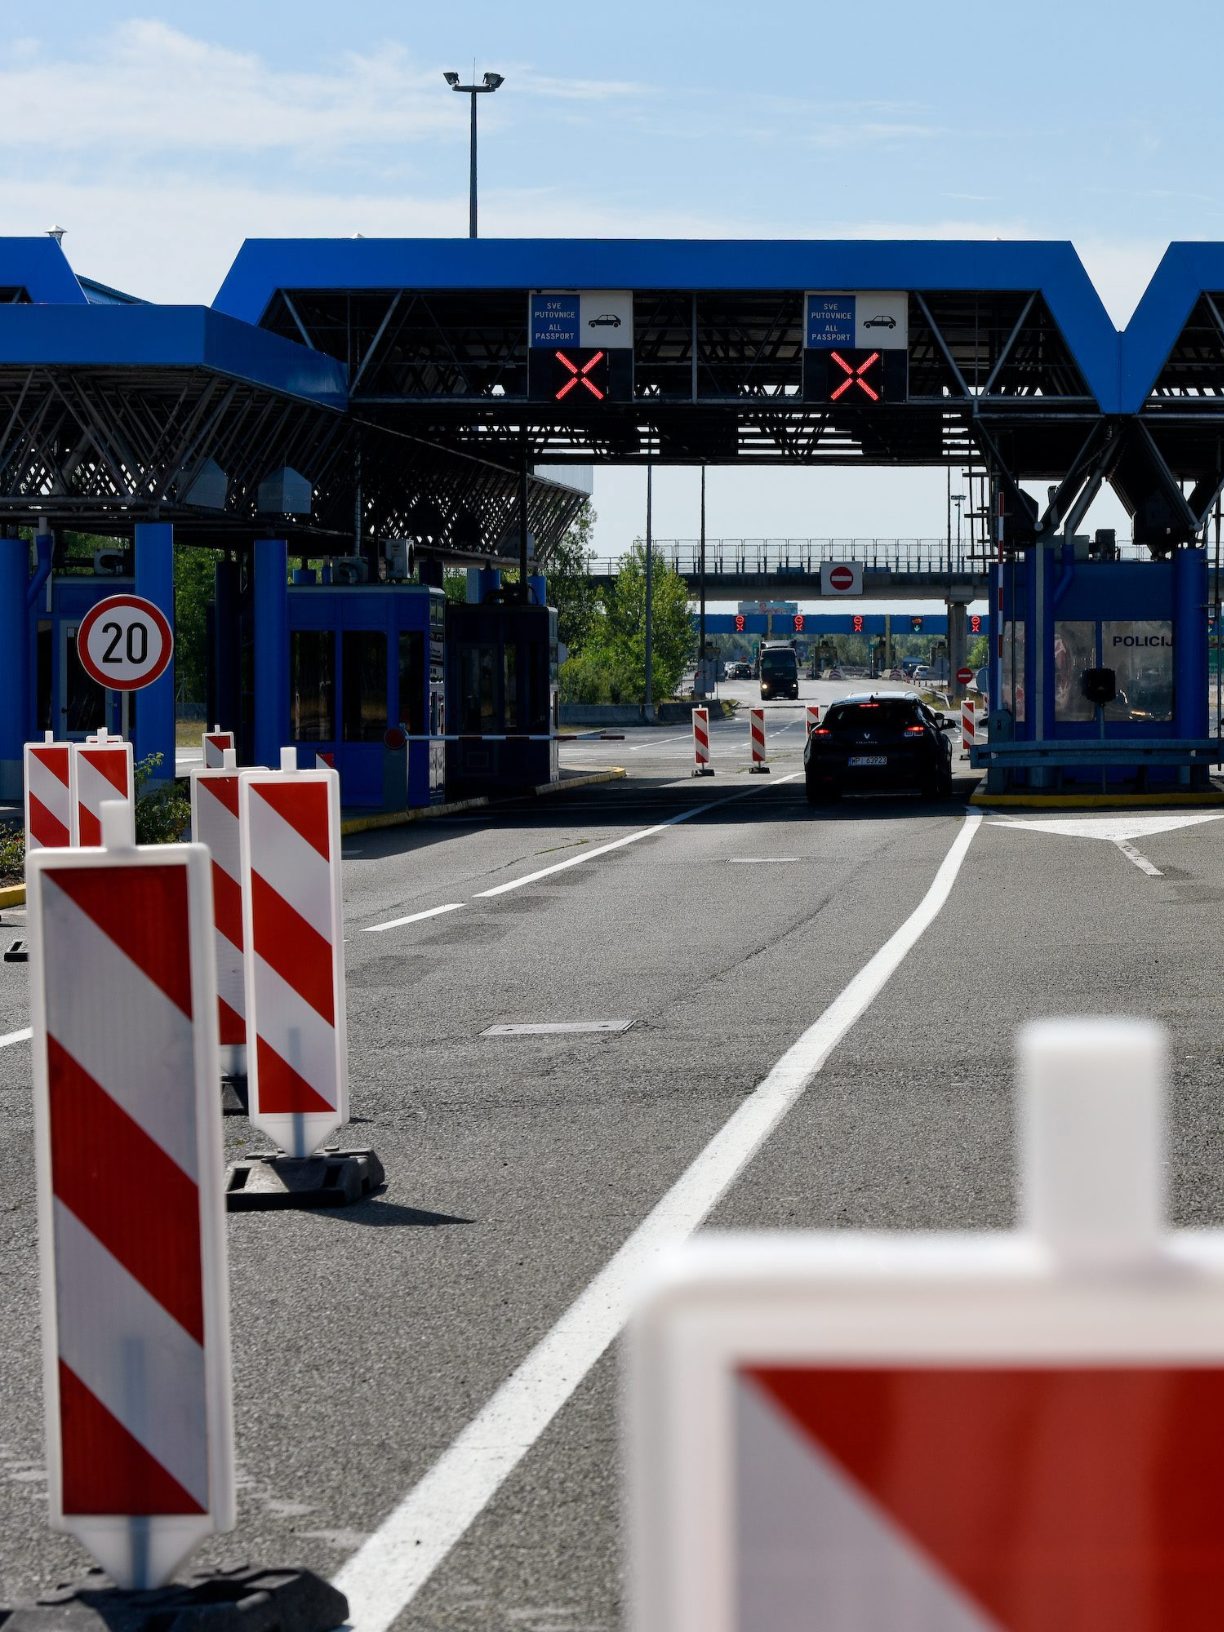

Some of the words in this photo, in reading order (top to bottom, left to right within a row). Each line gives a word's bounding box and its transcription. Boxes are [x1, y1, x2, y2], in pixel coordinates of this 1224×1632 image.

[547, 302, 562, 310] SVE
[823, 303, 838, 311] SVE
[535, 311, 575, 319] PUTOVNICE
[811, 312, 852, 320] PUTOVNICE
[535, 332, 575, 340] PASSPORT
[102, 622, 148, 665] 20
